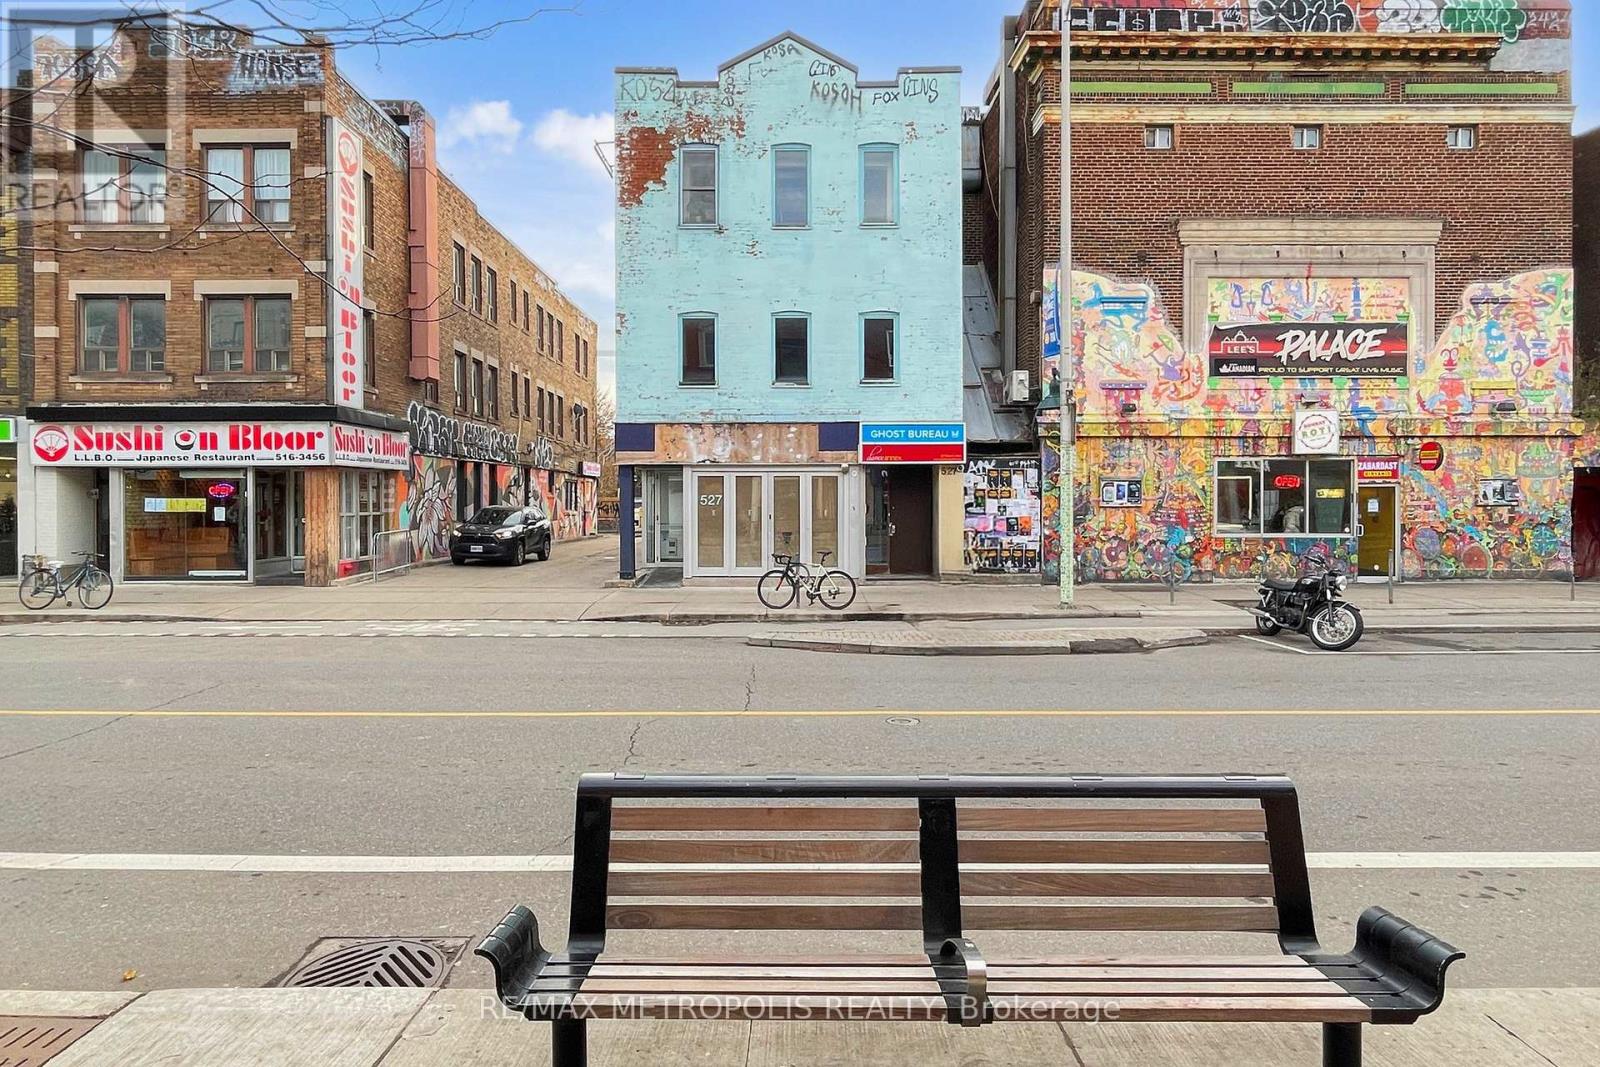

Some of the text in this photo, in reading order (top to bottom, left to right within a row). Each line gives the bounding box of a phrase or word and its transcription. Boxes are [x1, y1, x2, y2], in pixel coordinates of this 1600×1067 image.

[872, 92, 899, 105] FOX
[1227, 345, 1256, 354] LEE'S
[1273, 328, 1388, 366] PALACE
[340, 308, 358, 402] Bloor
[74, 424, 164, 451] Sushi
[229, 424, 324, 451] Bloor
[870, 430, 949, 438] GHOST BUREAU
[335, 427, 366, 454] Sushi
[382, 433, 409, 458] Bloor
[74, 454, 116, 462] L.L.B.O.
[136, 454, 189, 462] Japanese
[194, 454, 255, 462] Restaurant
[1358, 462, 1398, 470] ZABARDAST
[1275, 476, 1300, 487] OPEN
[700, 495, 723, 506] 527
